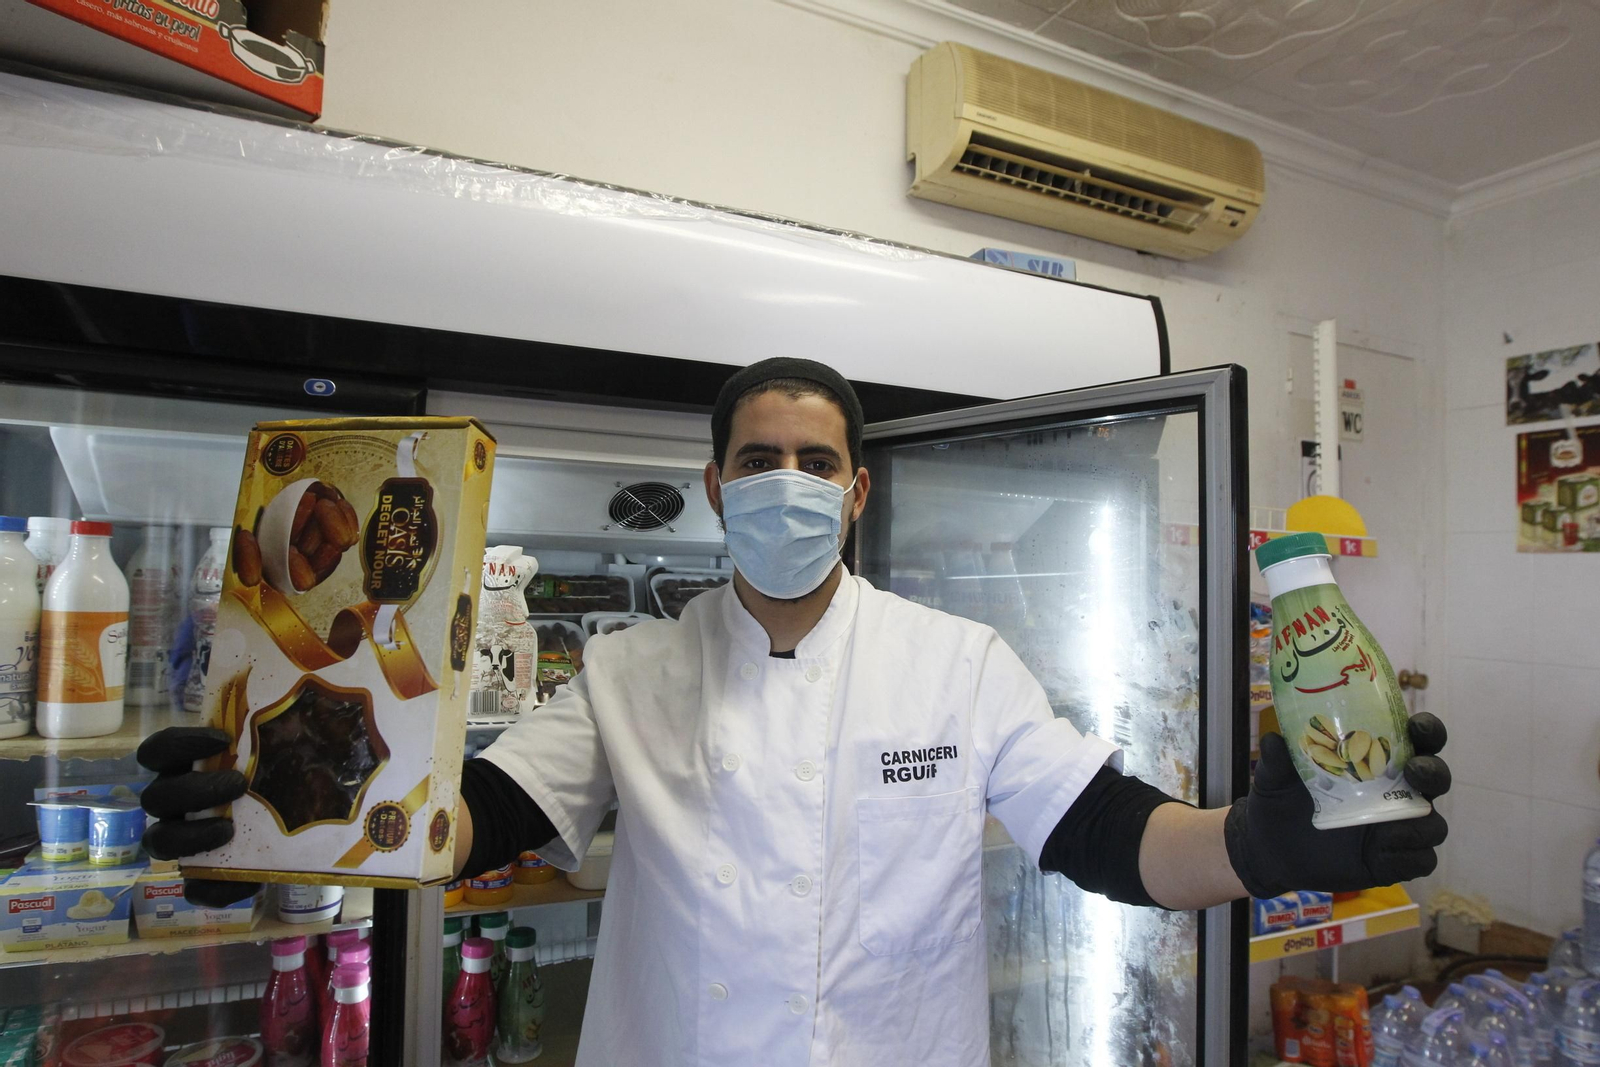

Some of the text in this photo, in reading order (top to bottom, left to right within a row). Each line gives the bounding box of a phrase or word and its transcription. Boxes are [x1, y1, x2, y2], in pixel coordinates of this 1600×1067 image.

[124, 18, 156, 35] sabrosas
[155, 10, 170, 28] en
[170, 18, 202, 42] perol
[1342, 411, 1362, 434] WC
[283, 440, 294, 467] DATES
[371, 495, 393, 589] DEGLET NOUR
[384, 507, 411, 568] OASIS
[483, 562, 516, 577] NAN
[1275, 605, 1331, 655] AFNAN
[1281, 605, 1354, 683] أفنان
[881, 745, 958, 766] CARNICERI
[386, 811, 397, 844] PREIUM
[145, 886, 183, 896] Pascual
[10, 899, 52, 910] Pascual
[1303, 904, 1330, 917] BIMBO
[204, 912, 232, 922] Yogur
[1267, 911, 1296, 925] BIMBO
[76, 925, 106, 935] Yogur
[170, 928, 221, 937] MACEDONIA
[1284, 936, 1315, 952] donuts
